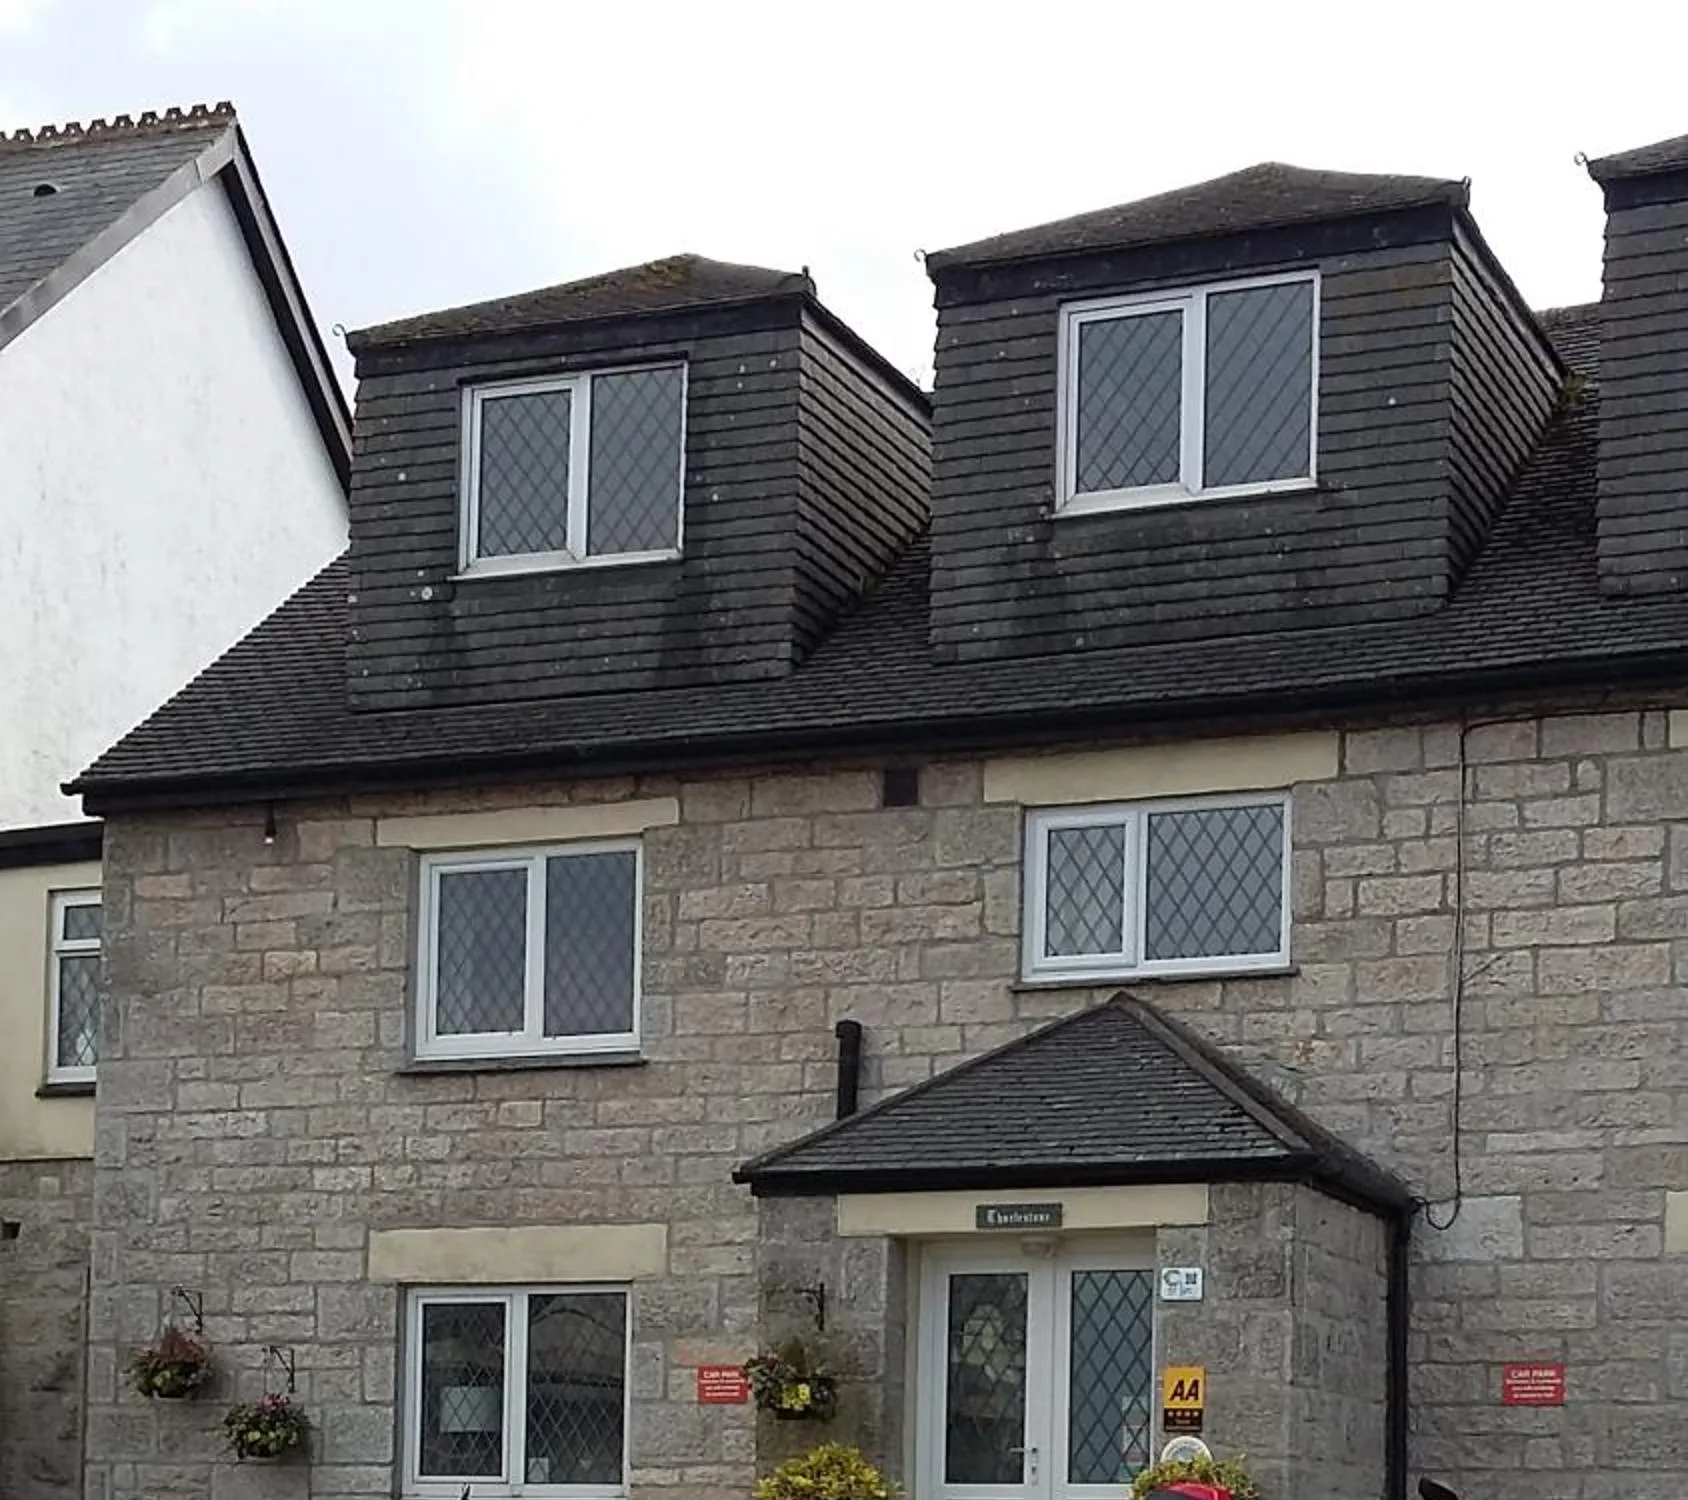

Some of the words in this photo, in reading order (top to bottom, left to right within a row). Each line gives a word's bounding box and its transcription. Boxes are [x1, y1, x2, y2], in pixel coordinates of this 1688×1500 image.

[703, 1370, 720, 1379] CAR
[1511, 1369, 1530, 1379] CAR
[1532, 1369, 1557, 1378] PARK
[1169, 1379, 1200, 1402] AA
